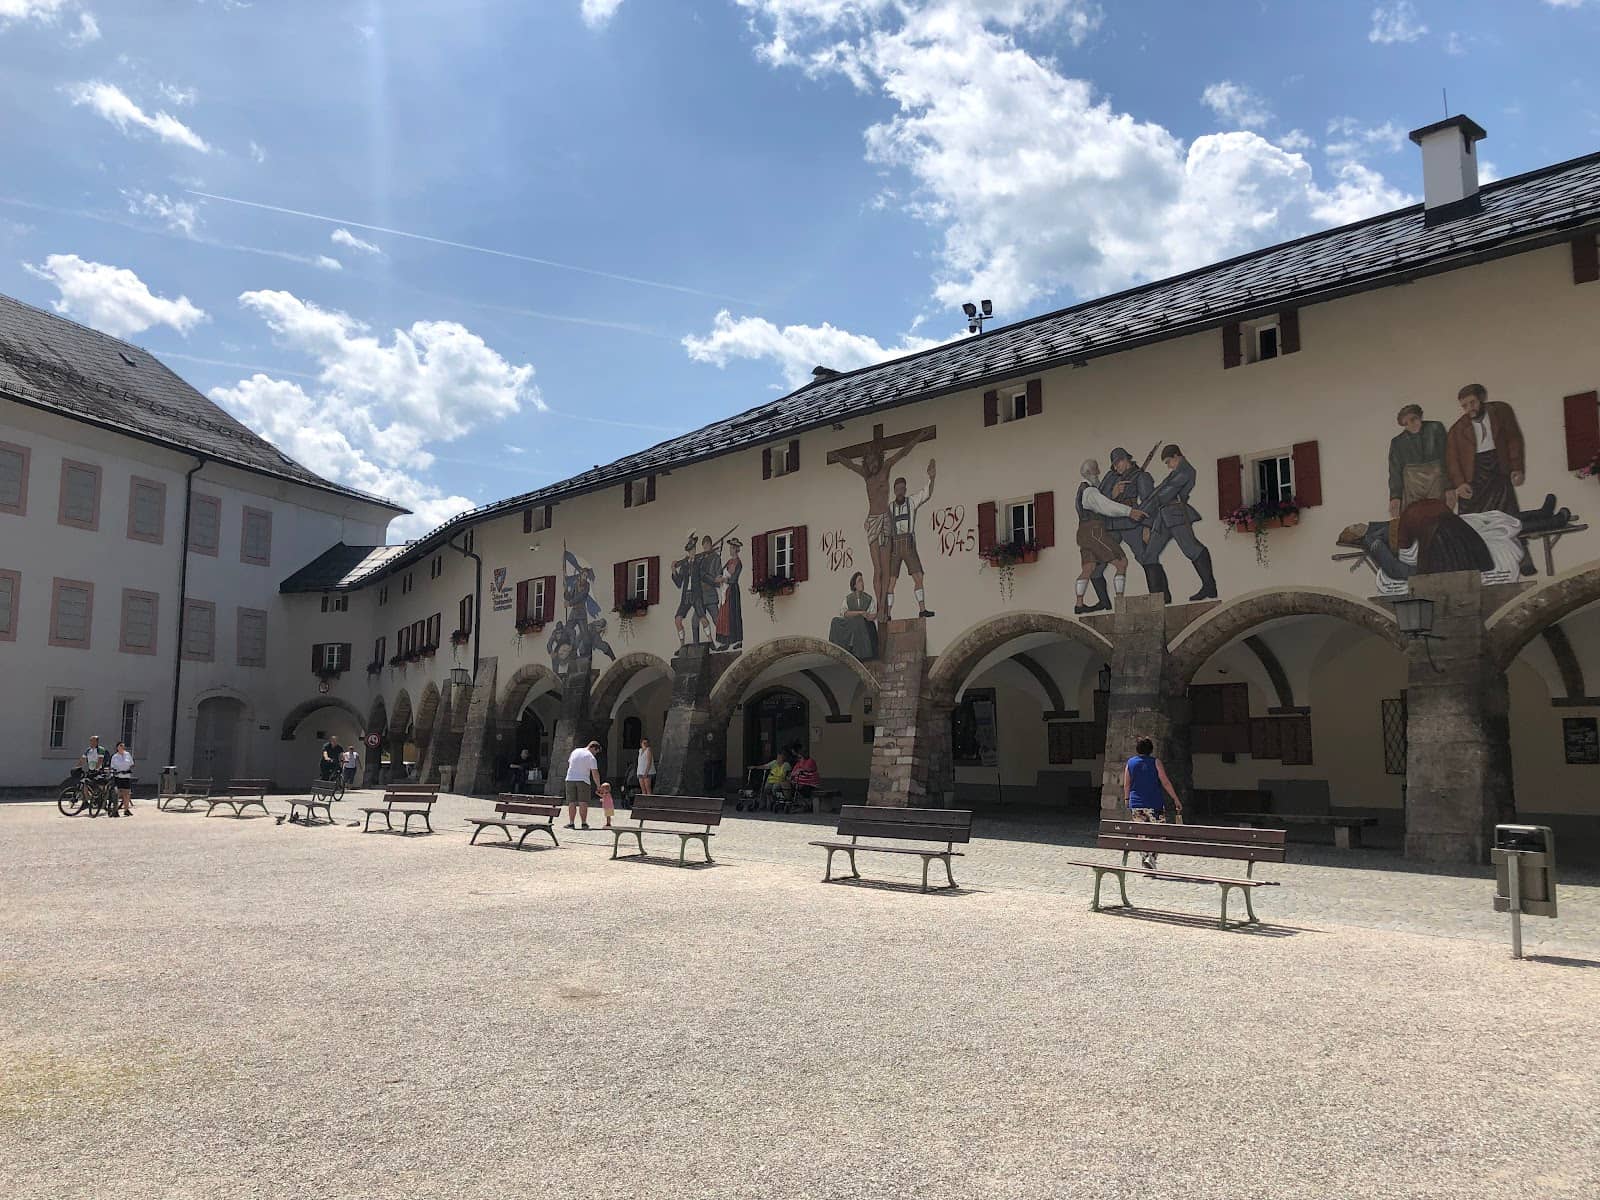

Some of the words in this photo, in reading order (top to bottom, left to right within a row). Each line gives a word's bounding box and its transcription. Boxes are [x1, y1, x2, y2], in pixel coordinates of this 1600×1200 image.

[932, 505, 966, 534] 1939
[821, 529, 846, 555] 1914
[941, 529, 976, 556] 1945
[830, 548, 854, 571] 1918
